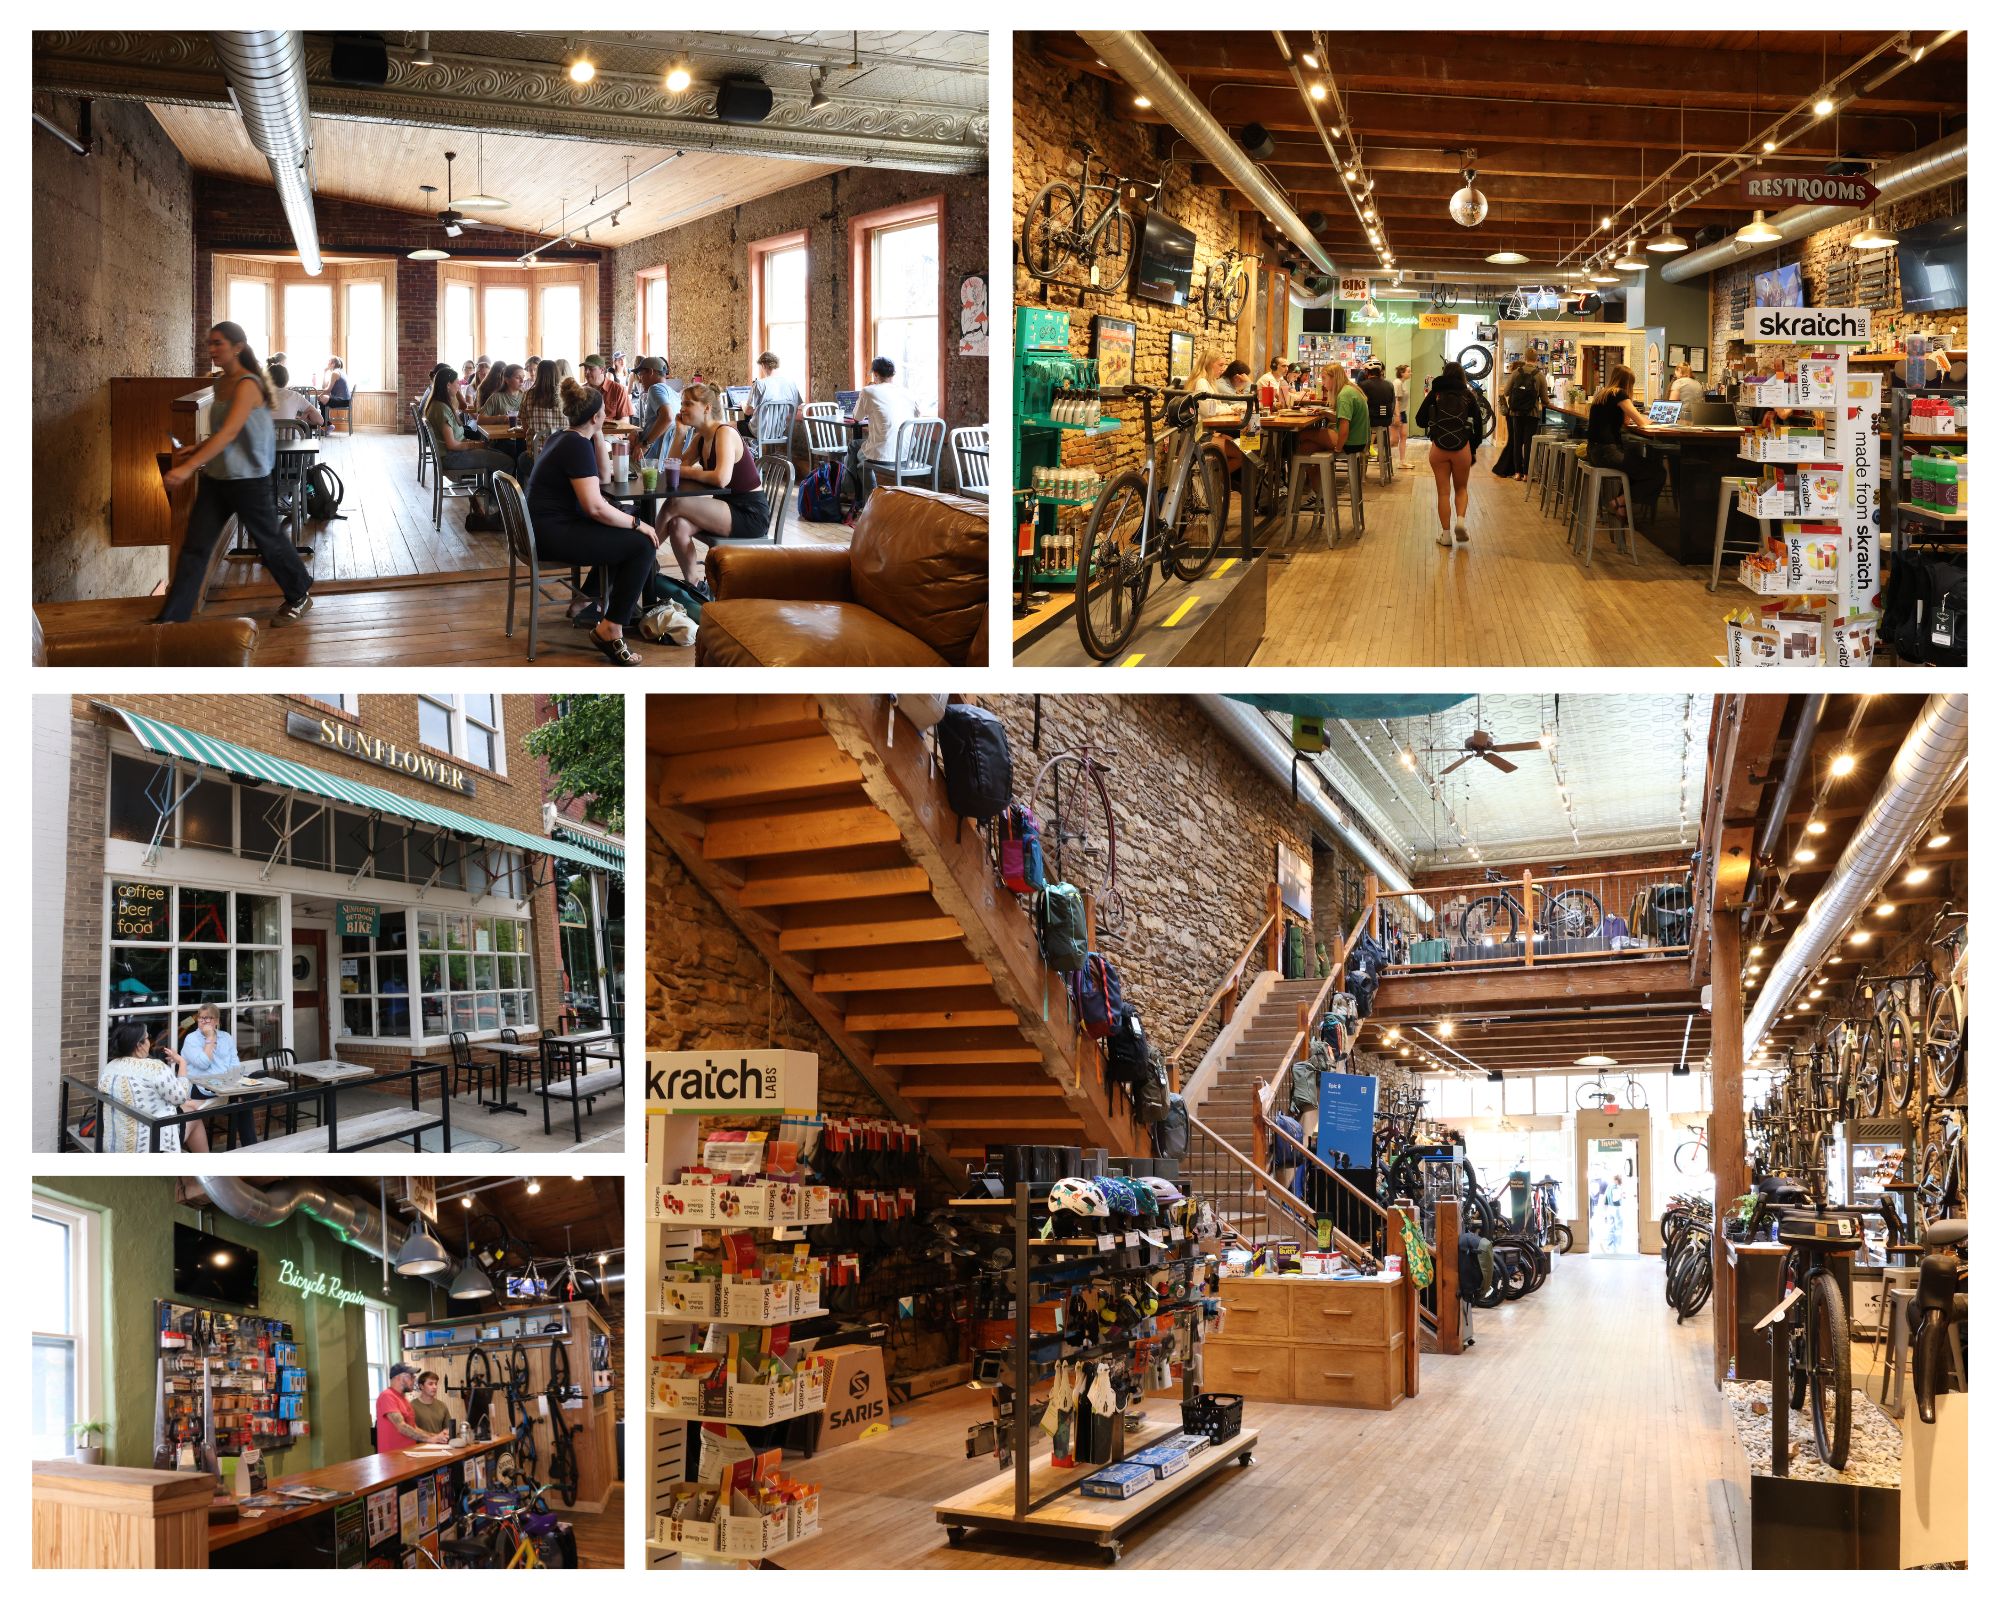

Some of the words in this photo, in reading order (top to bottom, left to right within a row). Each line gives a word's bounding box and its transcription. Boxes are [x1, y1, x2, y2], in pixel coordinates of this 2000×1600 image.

[1748, 178, 1866, 201] RESTROOMS
[1341, 279, 1366, 290] BIKE
[1388, 311, 1419, 328] Repair
[1858, 318, 1866, 337] LABS
[1856, 432, 1871, 477] made
[1857, 482, 1871, 519] from
[320, 718, 463, 790] SUNFLOWER
[118, 885, 164, 900] coffee
[119, 900, 153, 916] beer
[342, 905, 376, 917] SUNFLOWER
[117, 918, 153, 934] food
[346, 921, 372, 934] BIKE
[765, 1067, 777, 1099] LABS
[278, 1259, 326, 1299] Bicycle
[328, 1277, 366, 1308] Repair
[829, 1400, 884, 1430] SARIS
